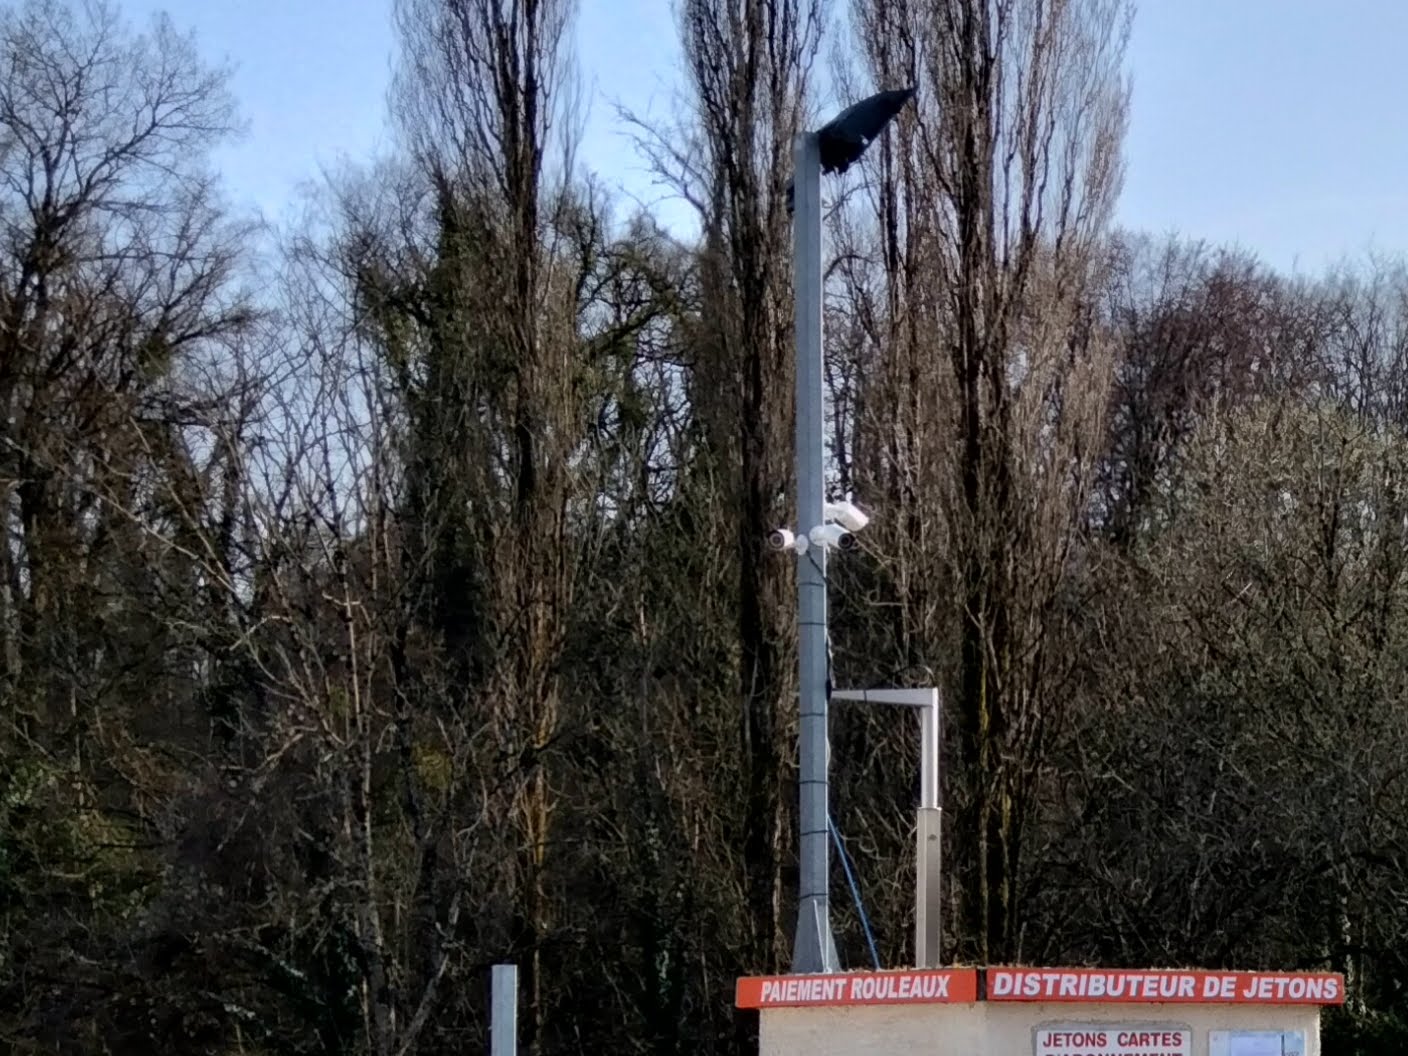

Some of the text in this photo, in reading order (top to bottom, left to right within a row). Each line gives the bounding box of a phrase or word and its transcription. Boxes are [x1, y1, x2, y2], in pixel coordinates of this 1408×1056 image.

[760, 975, 951, 1002] PAIEMENT ROULEAUX
[993, 971, 1340, 999] DISTRIBUTEUR DE JETONS
[1042, 1031, 1183, 1047] JETONS CARTES
